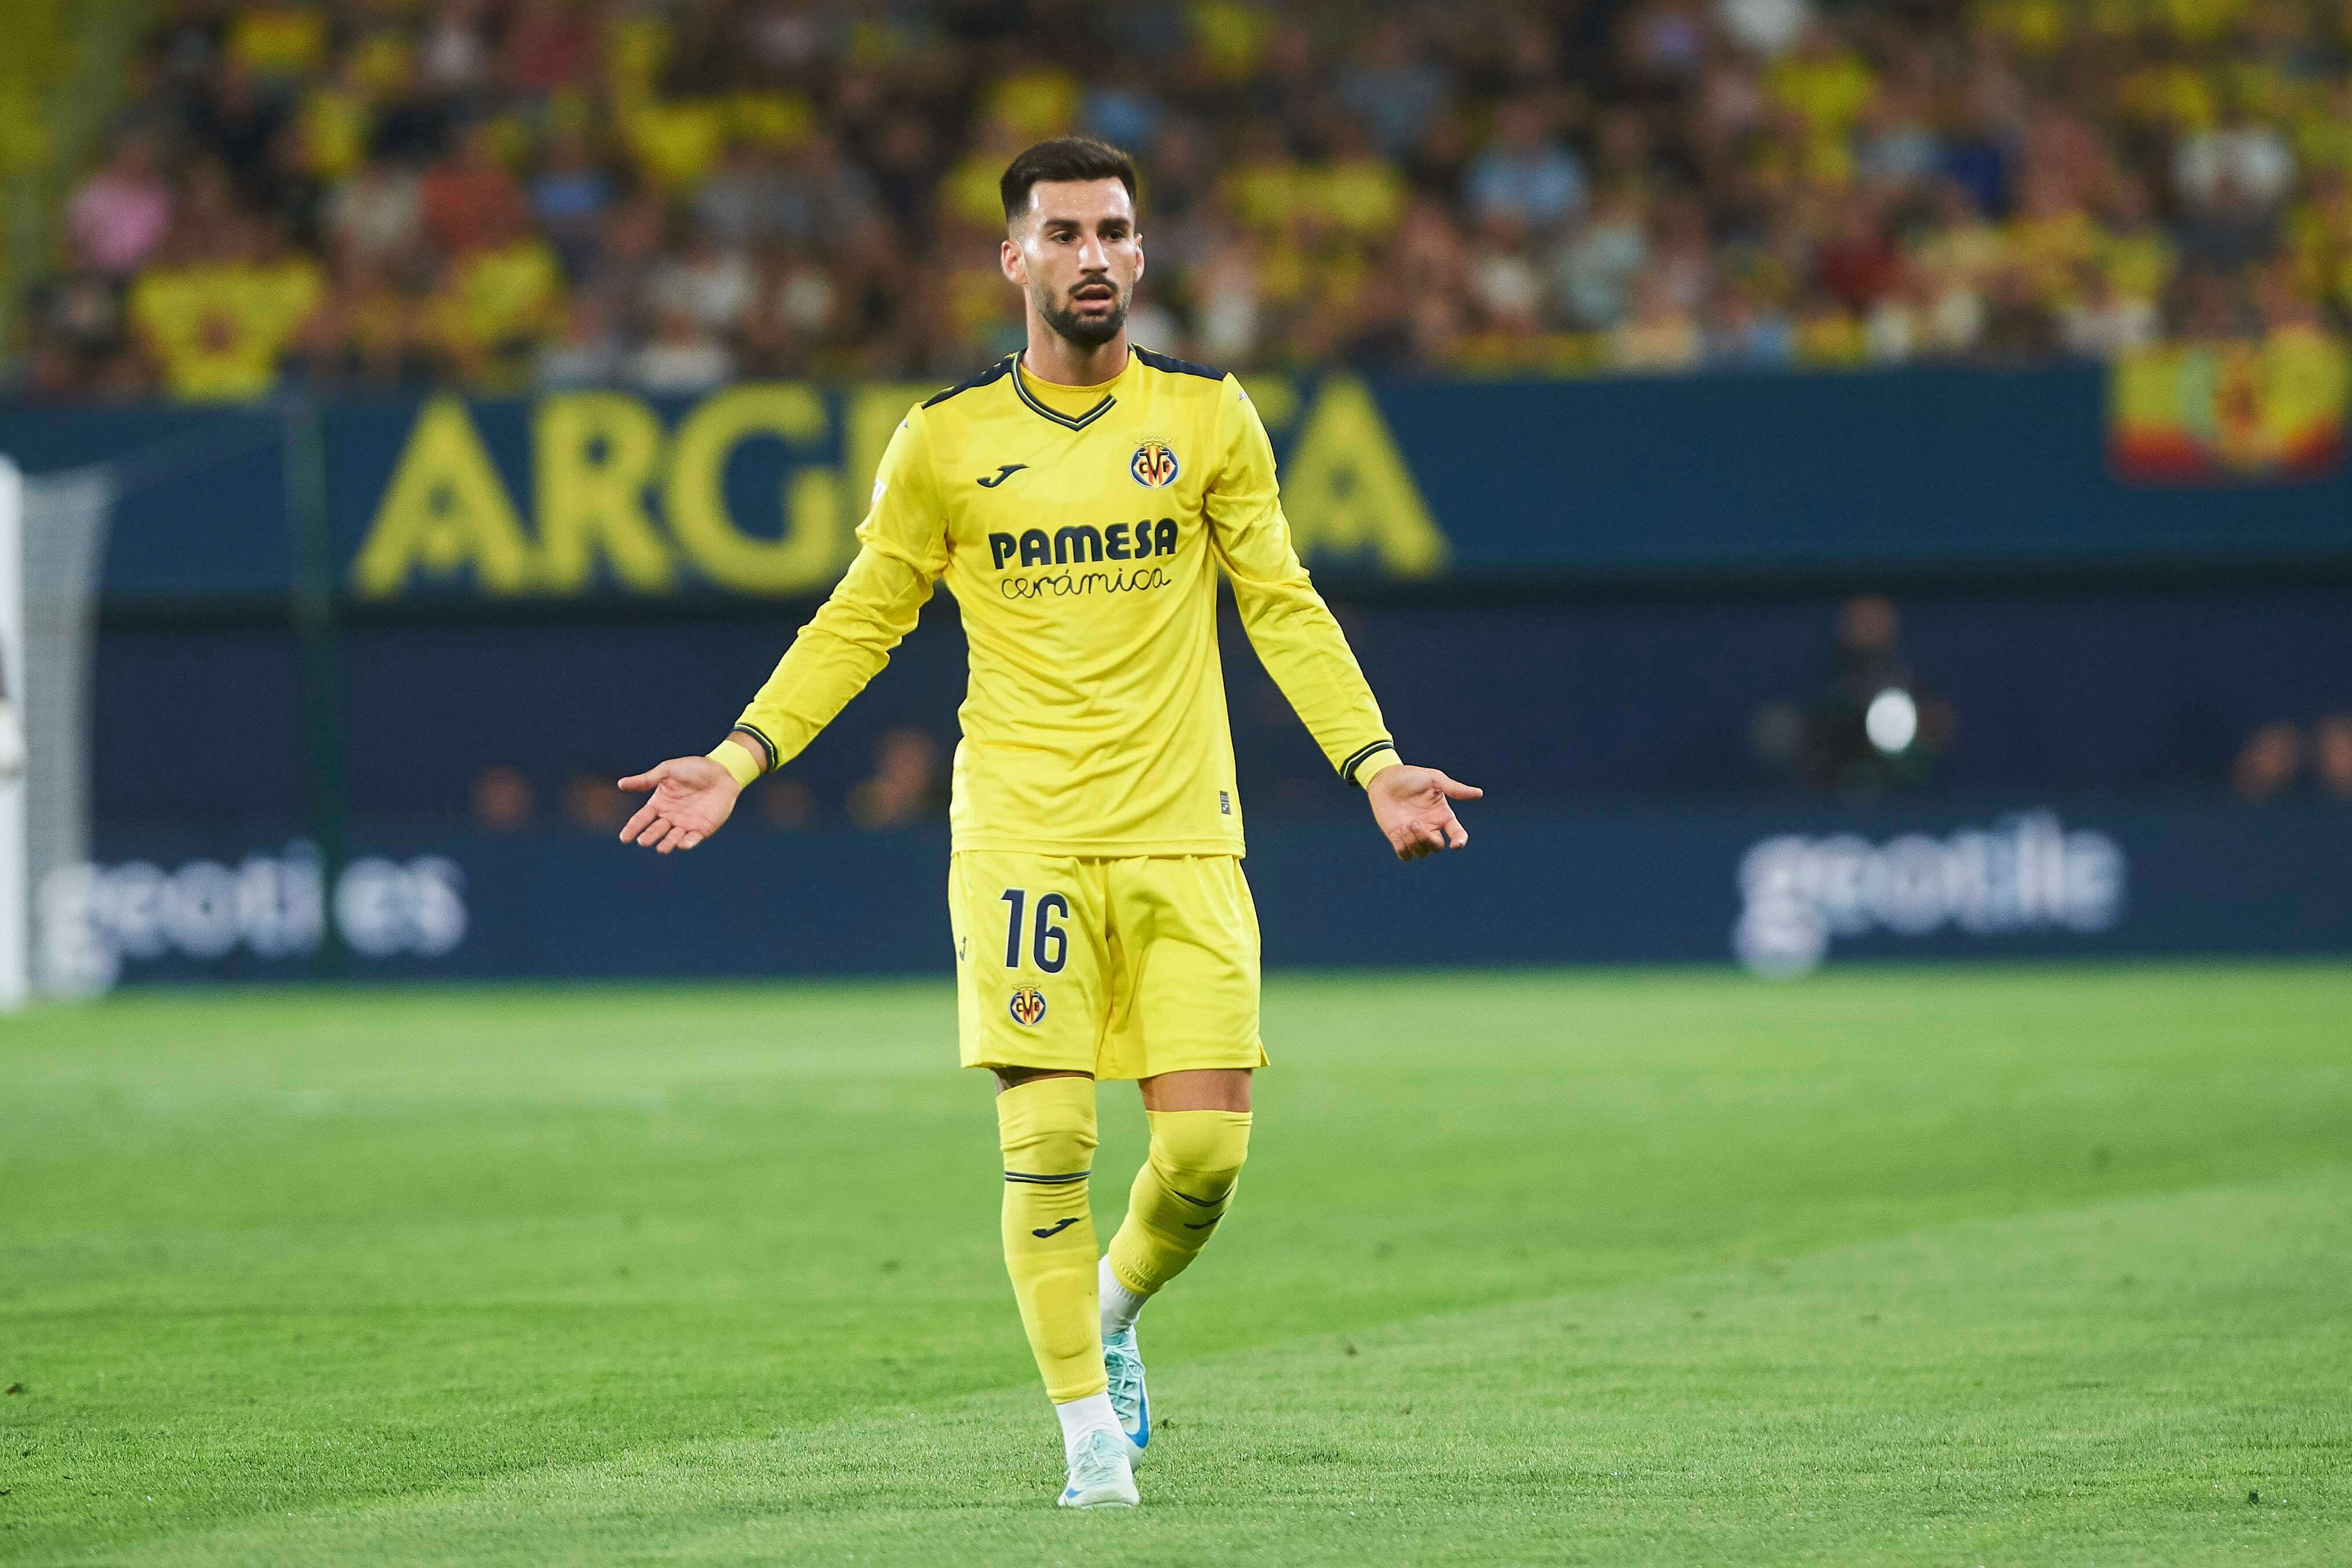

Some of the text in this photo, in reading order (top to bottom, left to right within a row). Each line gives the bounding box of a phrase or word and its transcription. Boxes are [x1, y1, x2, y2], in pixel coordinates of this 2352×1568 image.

[350, 369, 1454, 595] ARGA
[988, 518, 1179, 570] PAMESA
[1001, 567, 1172, 599] cerámica
[999, 888, 1070, 974] 16
